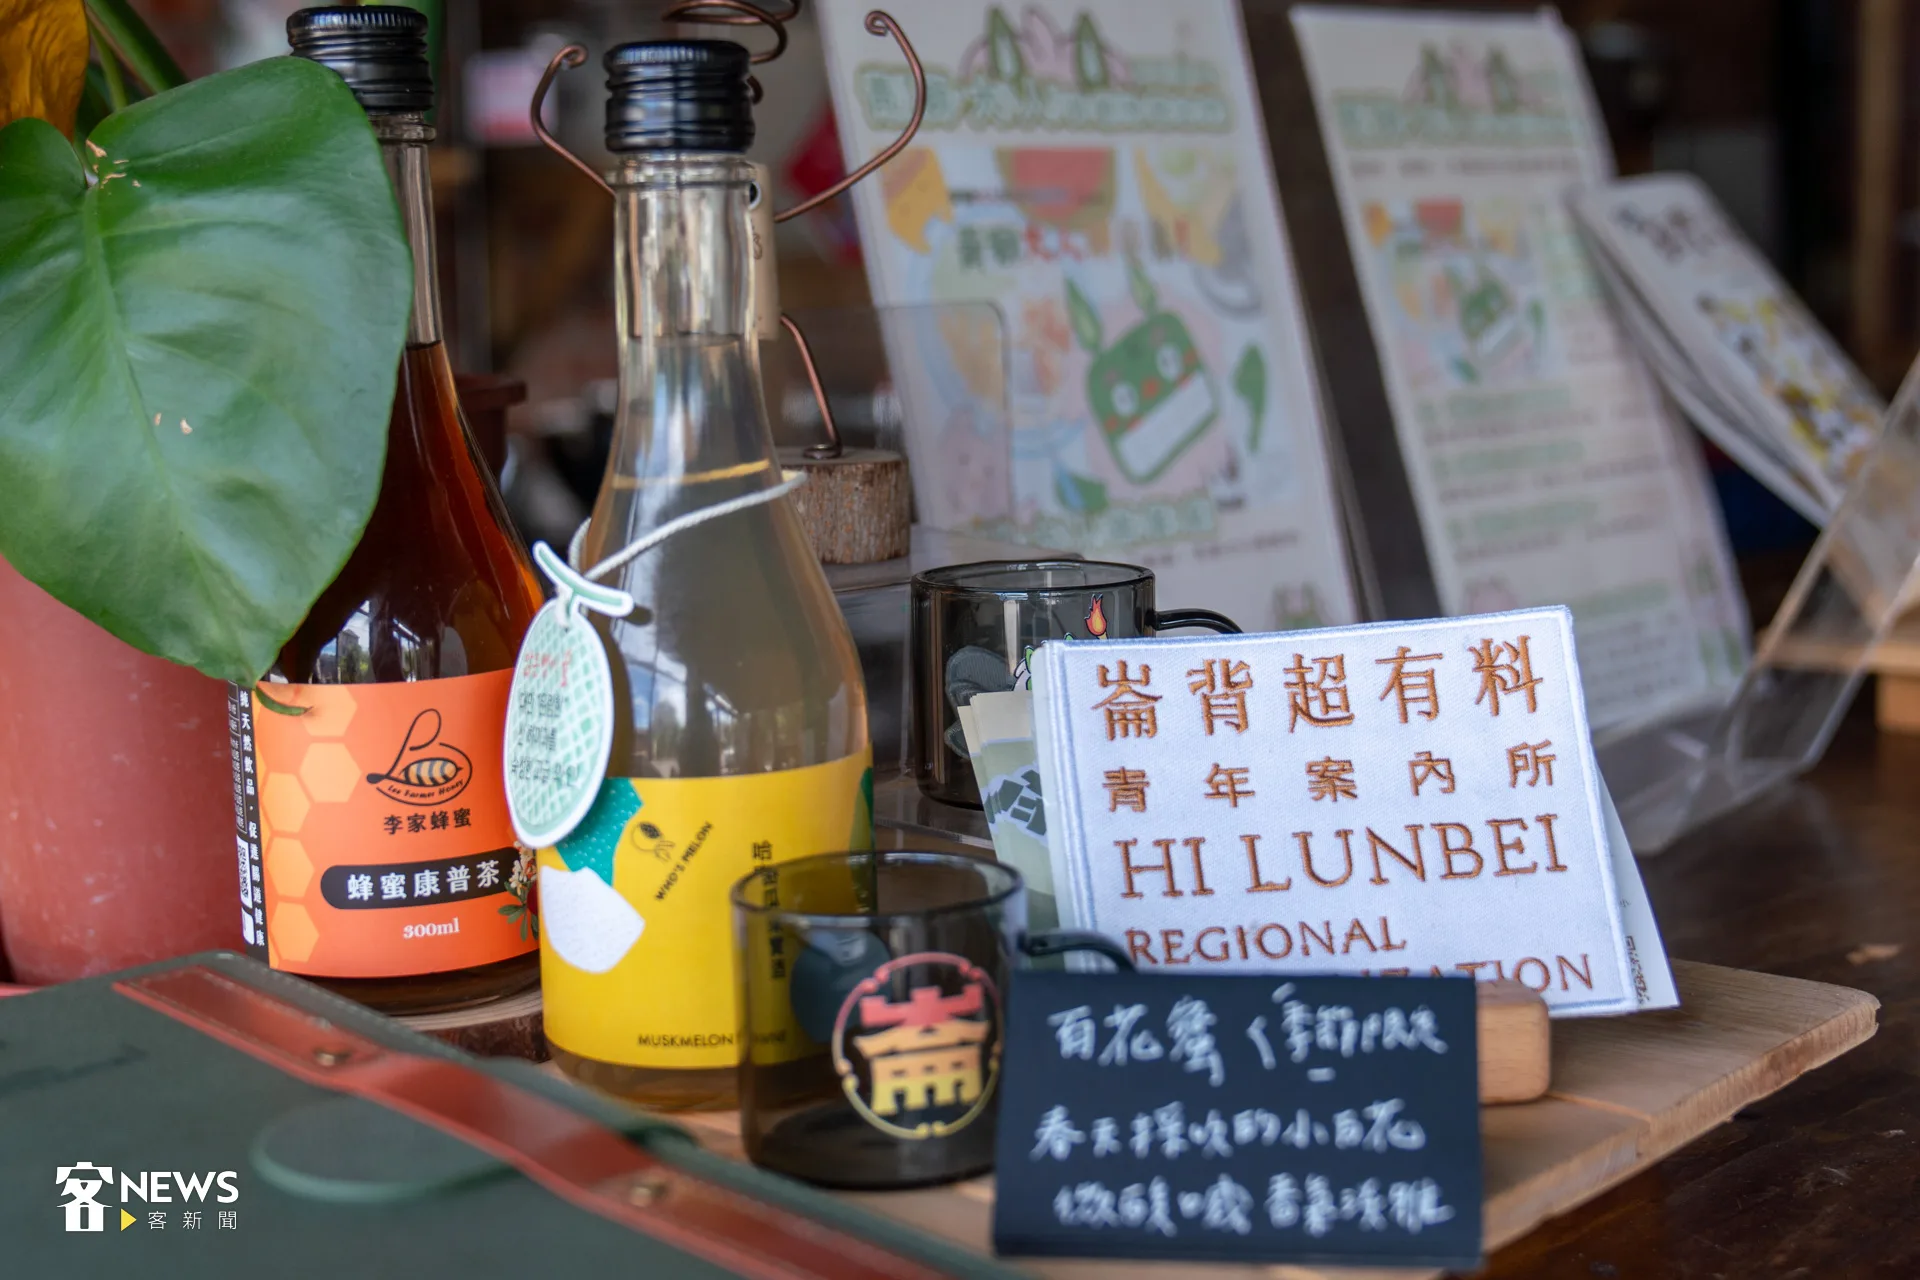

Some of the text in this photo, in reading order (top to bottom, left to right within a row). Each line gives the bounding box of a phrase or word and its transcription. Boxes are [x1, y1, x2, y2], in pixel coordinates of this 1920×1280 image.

[1091, 634, 1545, 742] 崙背超有料
[1102, 739, 1558, 813] 青年案內所
[383, 807, 472, 836] 李家蜂蜜
[654, 821, 714, 902] WHO'S MELON
[1113, 812, 1569, 898] HI LUNBEI
[347, 860, 501, 902] 蜂蜜康普茶
[403, 917, 461, 940] 300ml
[1124, 916, 1407, 967] REGIONAL
[637, 1032, 735, 1048] MUSKMELON
